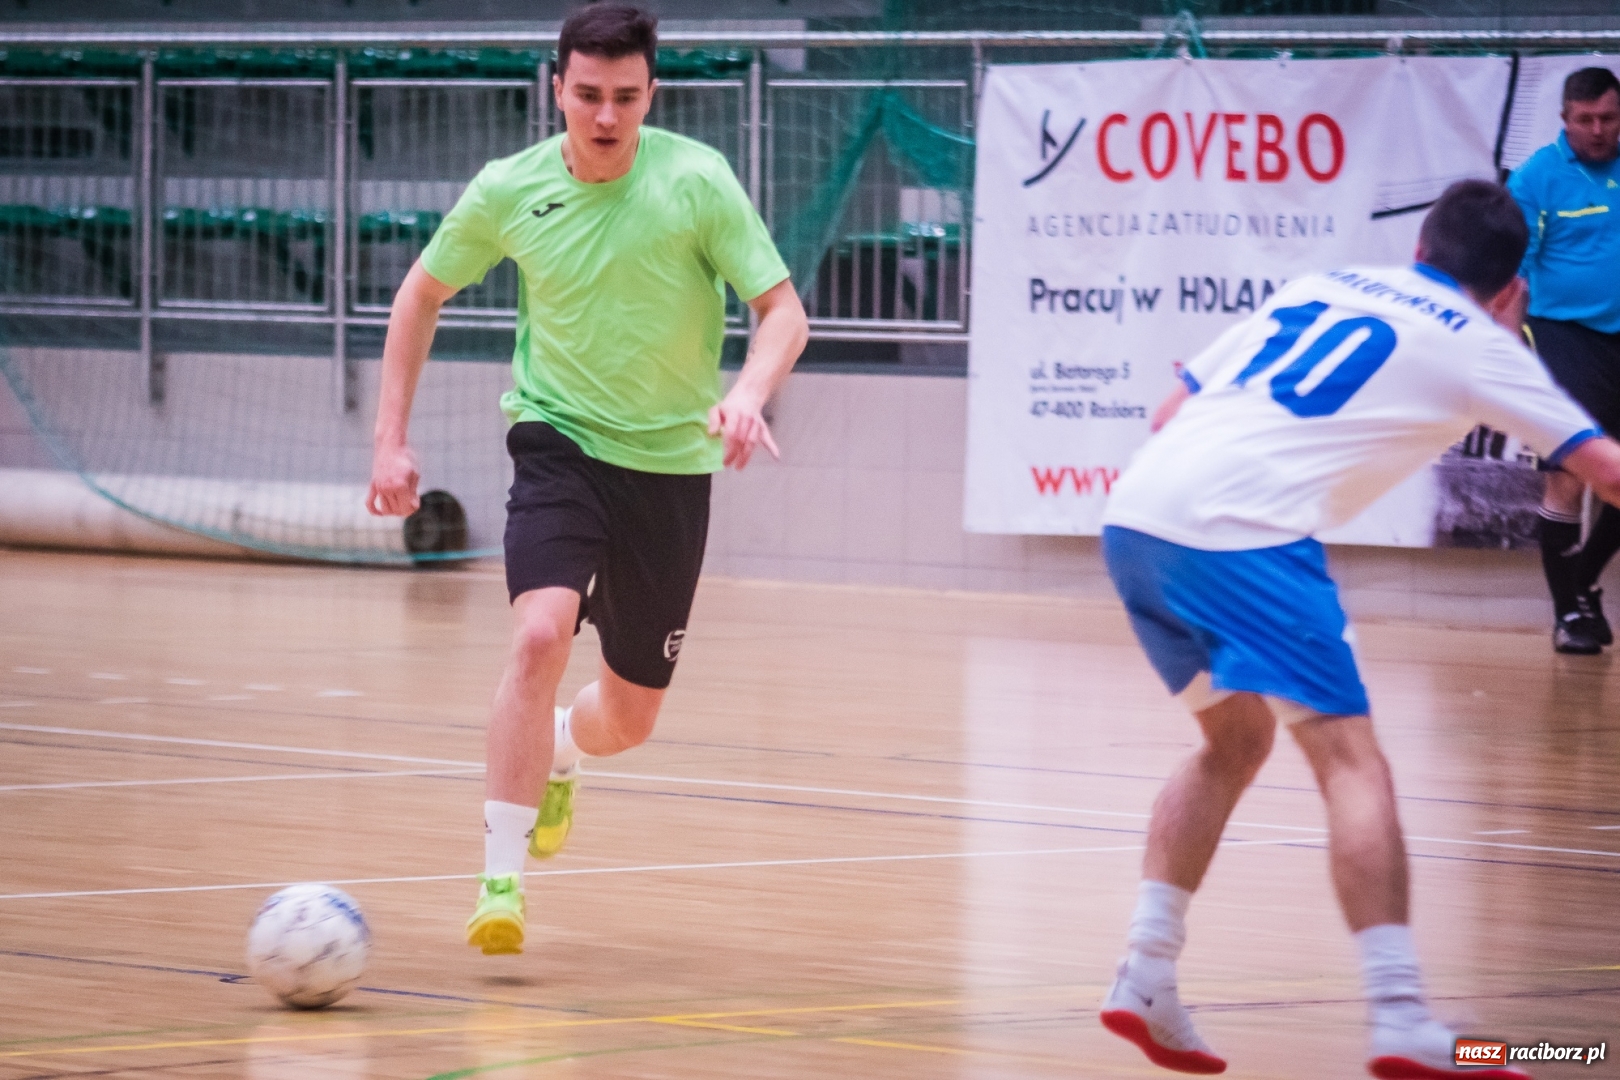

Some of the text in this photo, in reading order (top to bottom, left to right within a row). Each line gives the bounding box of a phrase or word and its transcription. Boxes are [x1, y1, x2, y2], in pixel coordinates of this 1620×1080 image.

[1096, 112, 1345, 183] COVEBO
[1030, 275, 1124, 324] Pracuj
[1132, 287, 1162, 313] w
[1229, 300, 1398, 419] 10
